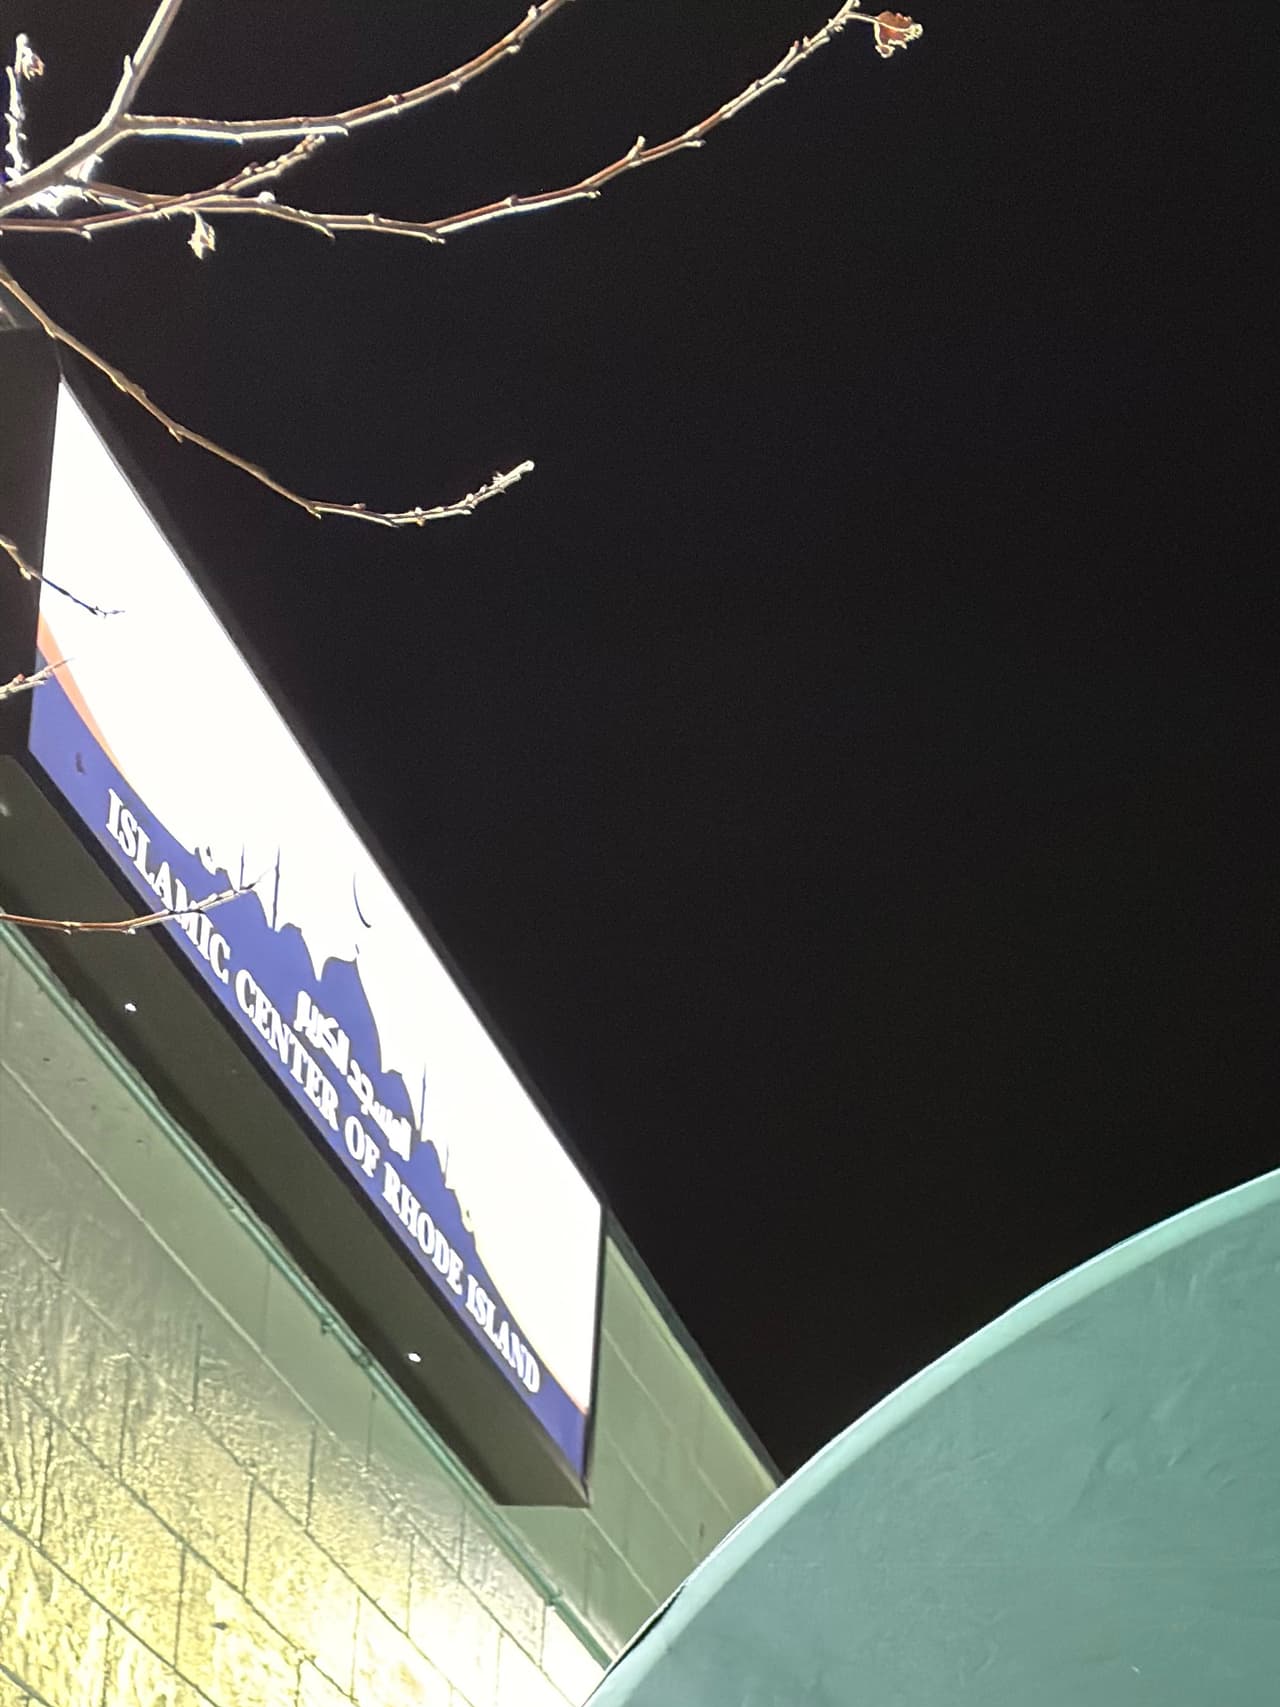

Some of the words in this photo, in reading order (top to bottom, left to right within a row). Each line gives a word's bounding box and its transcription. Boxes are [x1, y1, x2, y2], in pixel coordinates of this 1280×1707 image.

[105, 787, 231, 984] ISLAMIC
[234, 969, 340, 1132] CENTER
[344, 1115, 381, 1178] OF
[381, 1161, 464, 1296] RHODE
[464, 1274, 541, 1394] ISLAND
